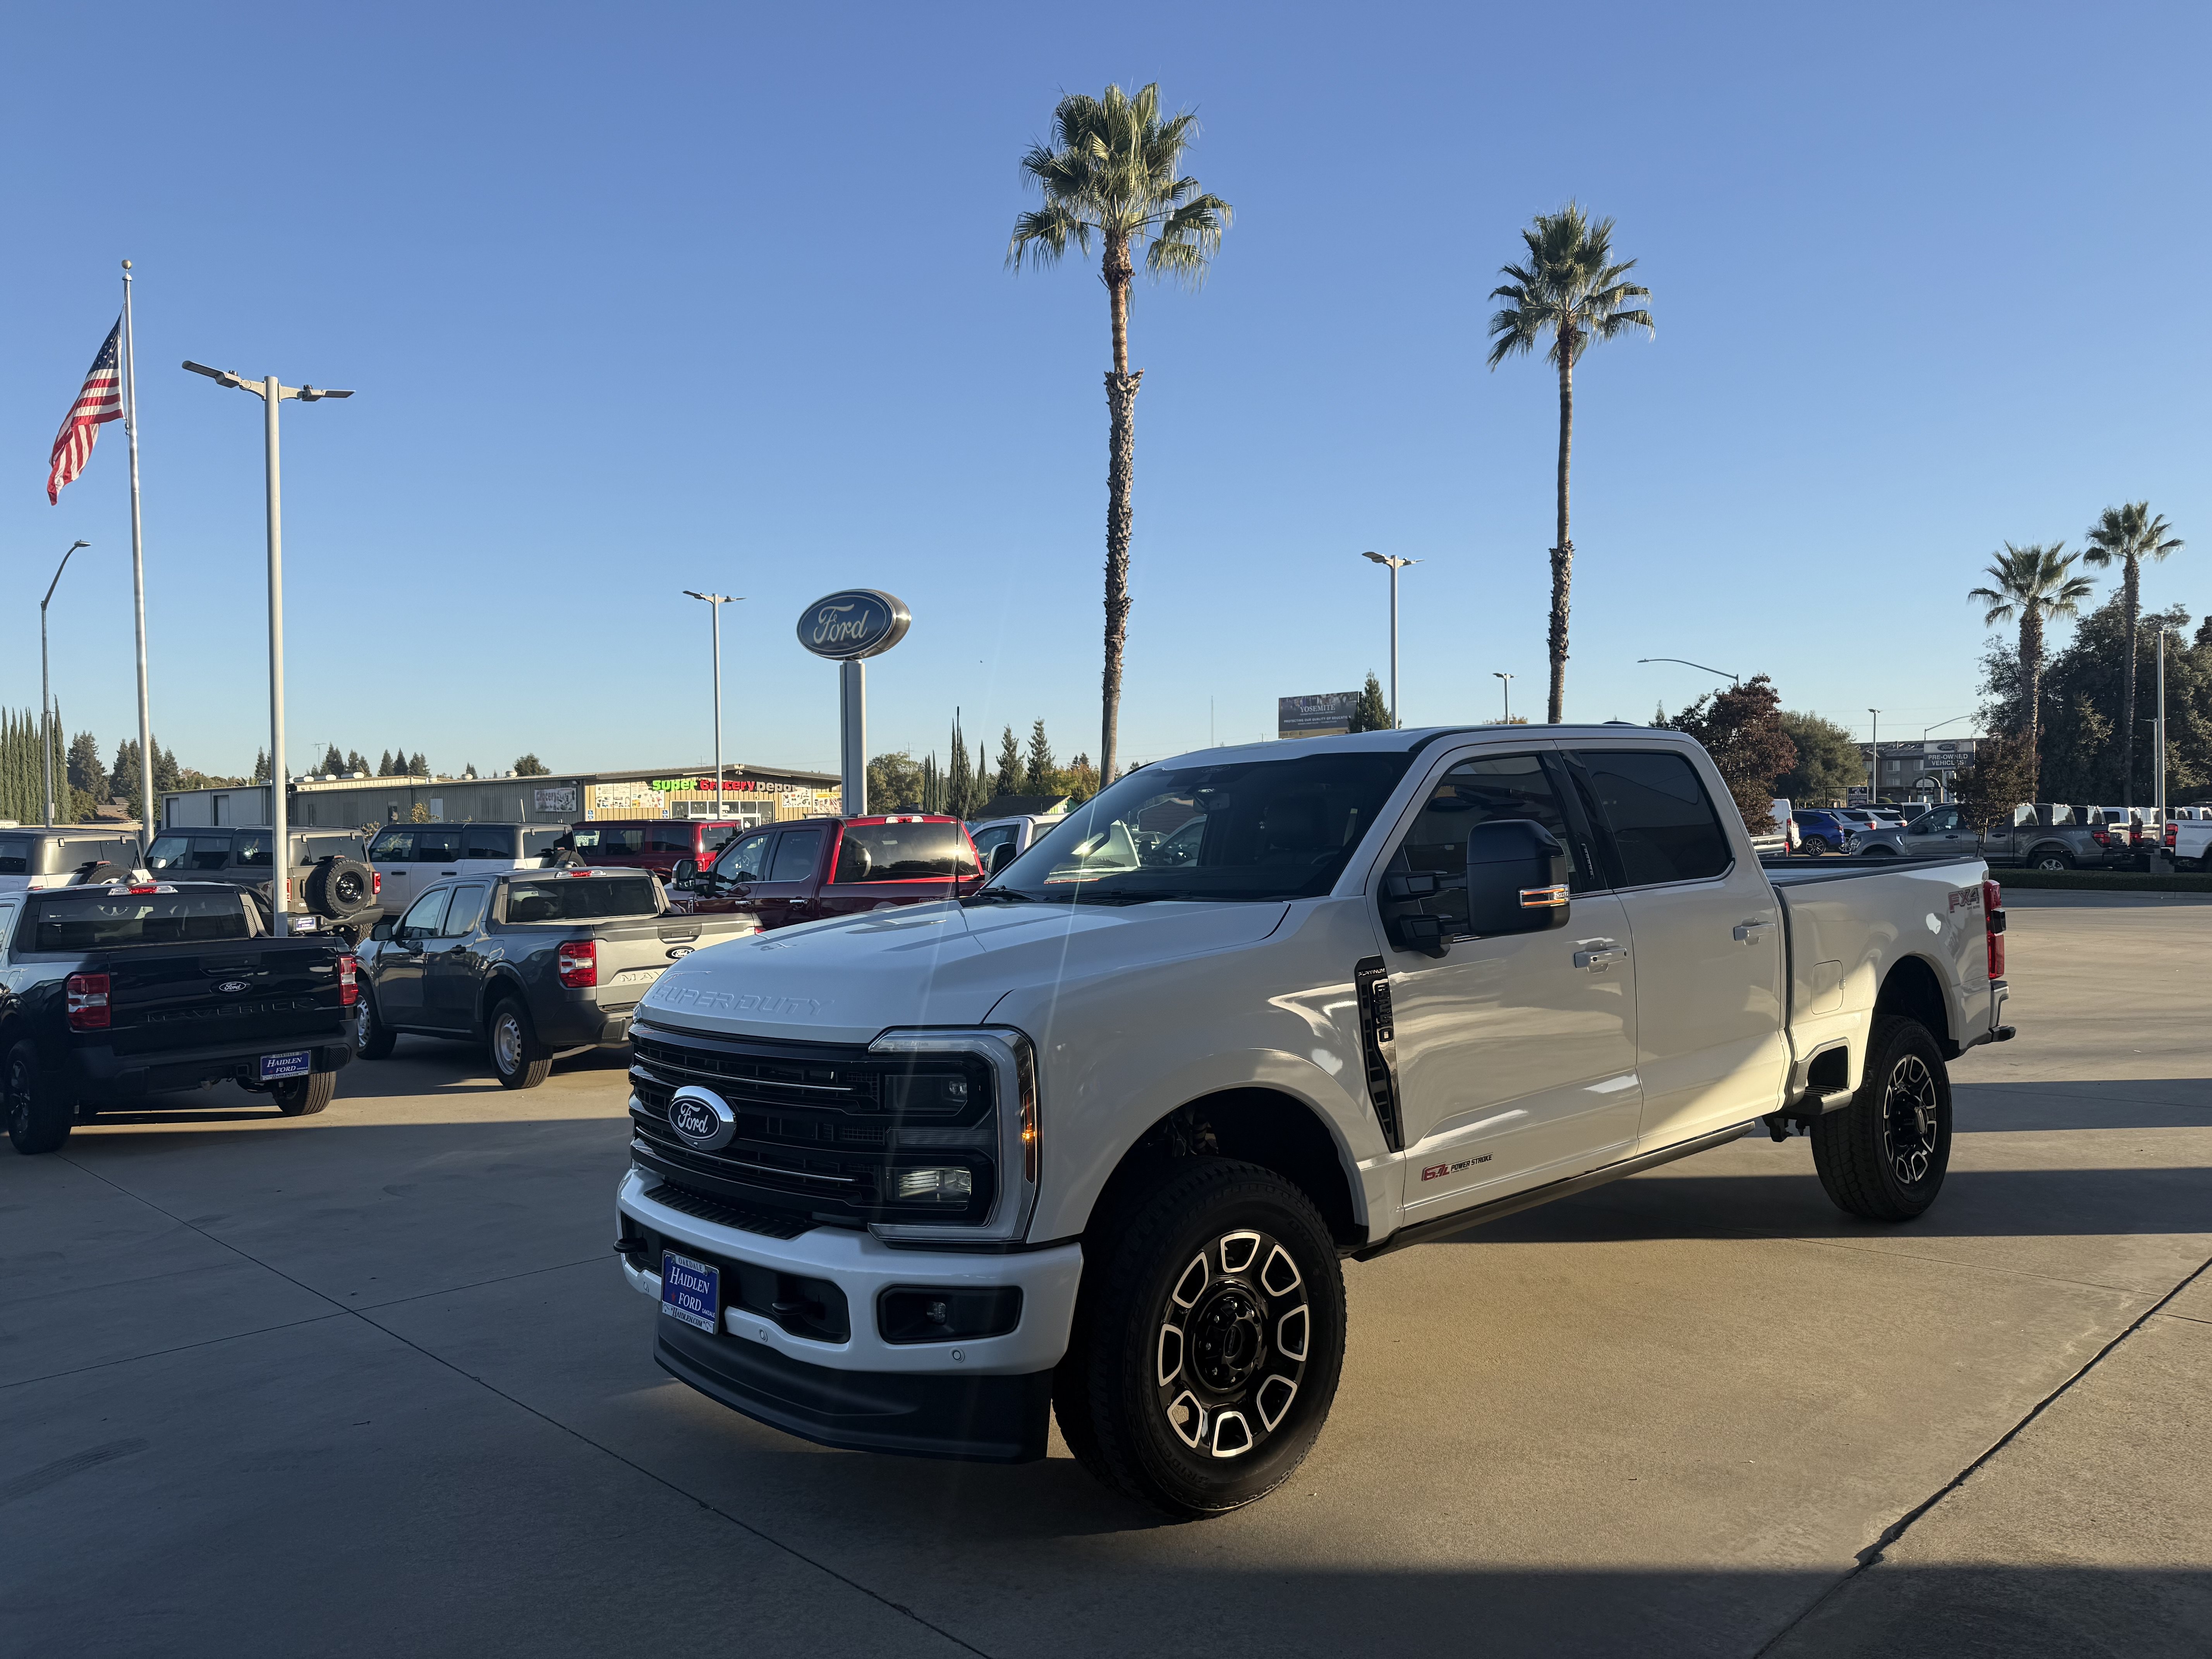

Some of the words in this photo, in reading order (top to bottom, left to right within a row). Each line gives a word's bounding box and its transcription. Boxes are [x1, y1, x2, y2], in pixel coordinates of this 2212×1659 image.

[813, 603, 870, 644] Ford
[1300, 704, 1336, 713] YOSEMITE
[1948, 888, 1980, 914] FX4
[1358, 968, 1386, 976] PLATINUM
[148, 1000, 311, 1022] MAVERICK
[653, 986, 734, 1009] SUPER
[734, 995, 835, 1016] DUTY
[678, 1103, 708, 1133] Ford
[1422, 1162, 1450, 1181] 6.7L
[1451, 1160, 1470, 1171] POWER
[1471, 1154, 1493, 1165] STROKE
[678, 1257, 702, 1272] OAKDALE
[669, 1266, 709, 1294] HAIDLEN
[678, 1292, 701, 1311] FORD
